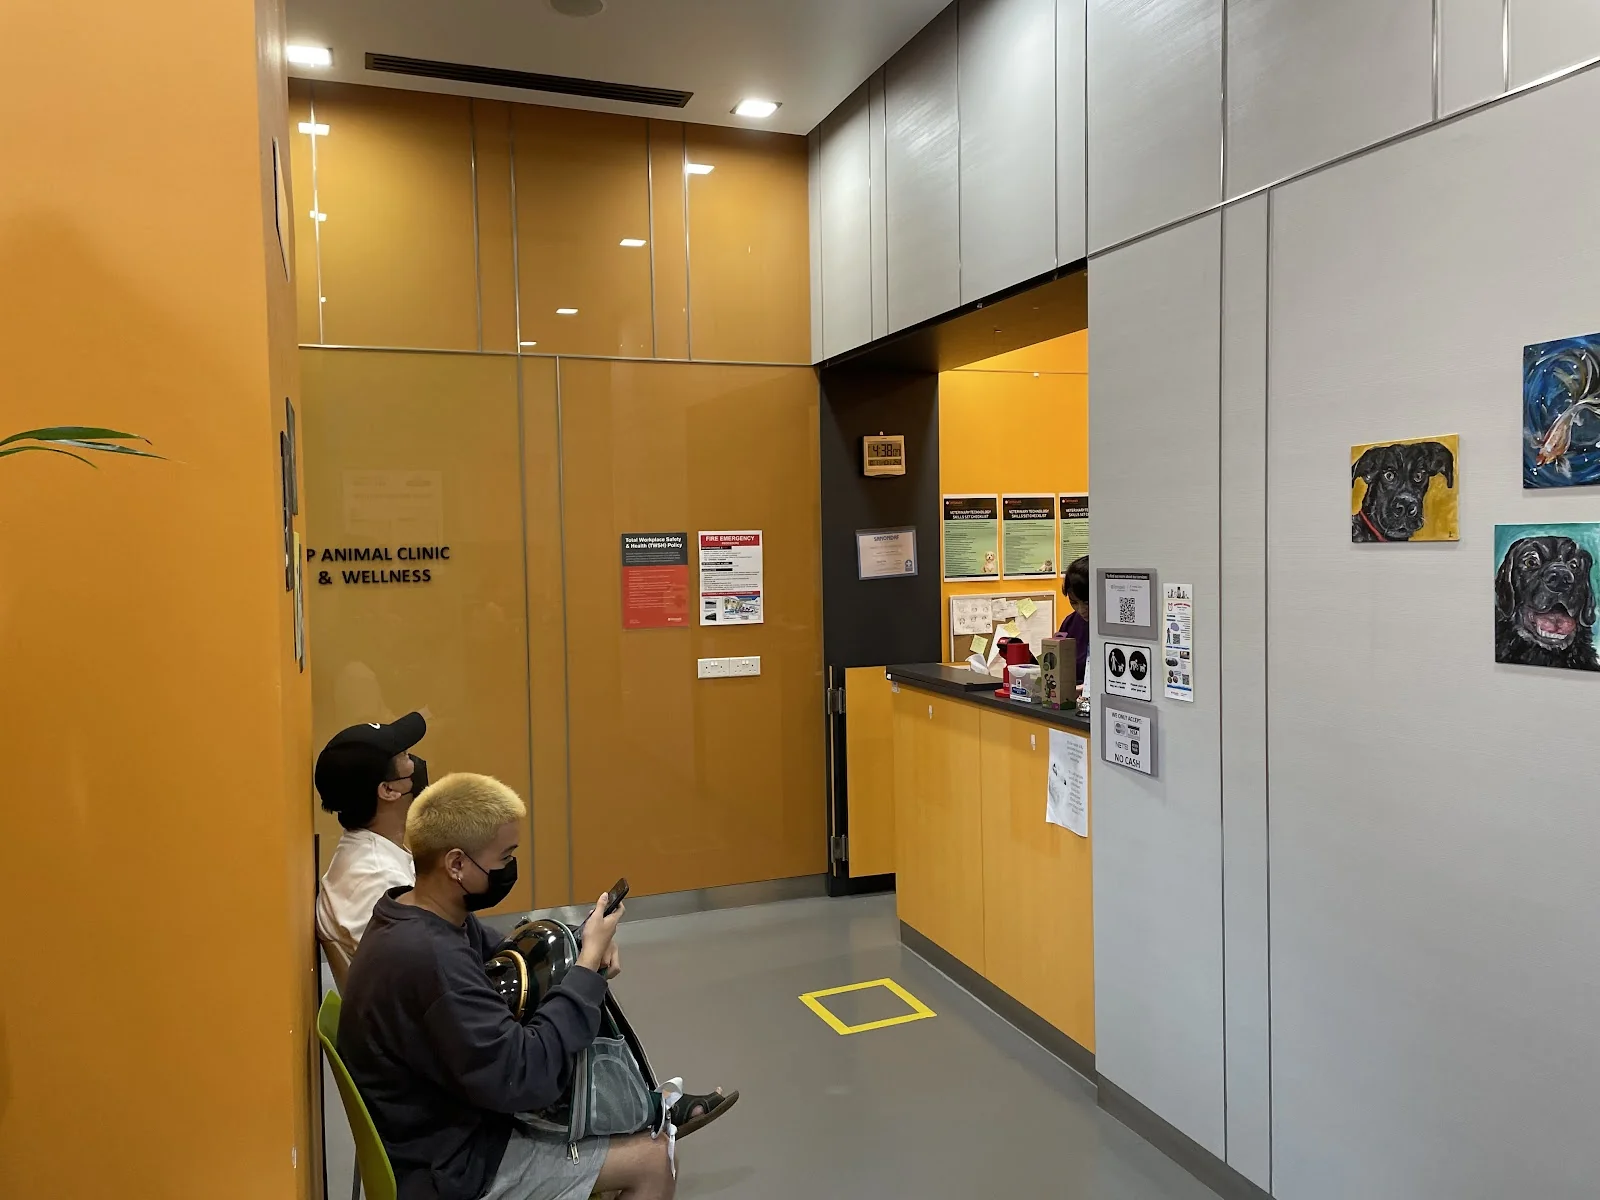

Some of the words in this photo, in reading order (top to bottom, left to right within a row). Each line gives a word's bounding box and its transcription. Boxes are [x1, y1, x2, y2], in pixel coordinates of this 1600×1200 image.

[873, 444, 892, 457] 4:38
[321, 548, 393, 561] ANIMAL
[398, 547, 450, 560] CLINIC
[318, 571, 333, 584] &
[342, 569, 432, 584] WELLNESS
[1115, 753, 1123, 763] NO
[1125, 756, 1140, 768] CASH
